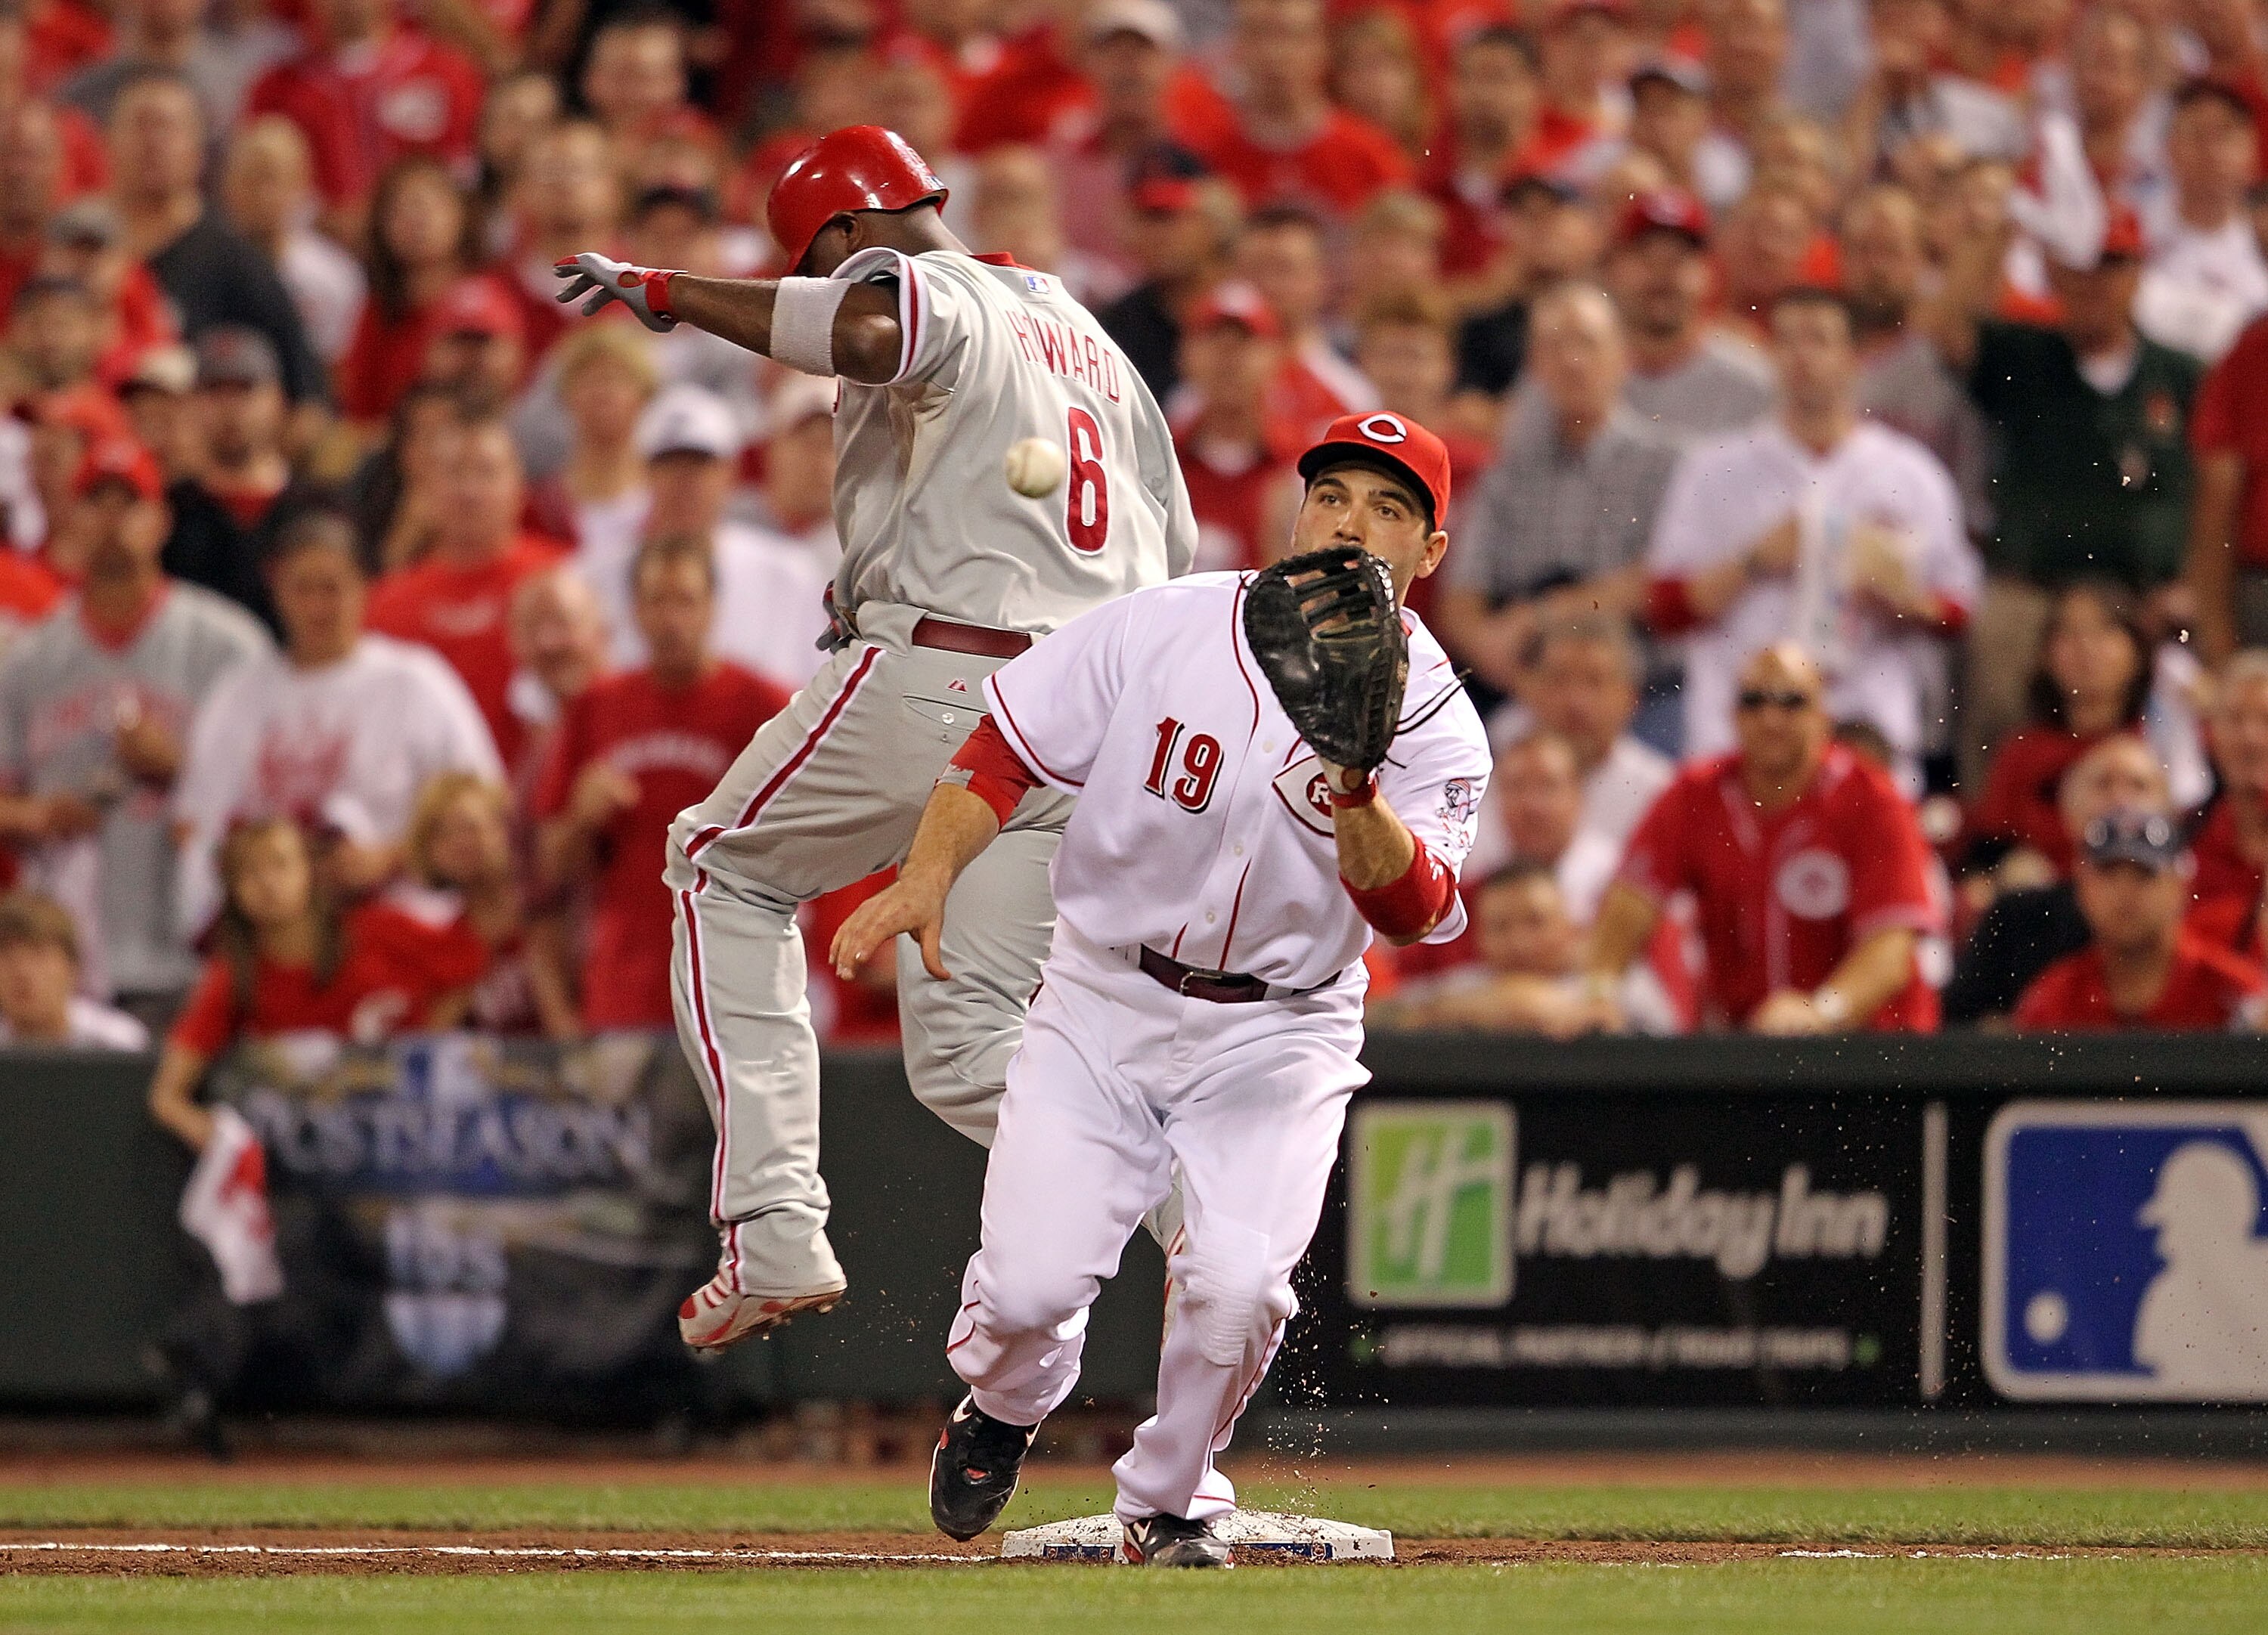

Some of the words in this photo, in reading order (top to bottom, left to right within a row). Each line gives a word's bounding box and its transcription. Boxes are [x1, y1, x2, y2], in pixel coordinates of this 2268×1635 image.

[1004, 308, 1121, 406] HWARD
[1064, 404, 1111, 556] 6
[1144, 716, 1224, 815] 19
[1517, 1163, 1773, 1279] Holiday
[1777, 1163, 1885, 1259] Inn
